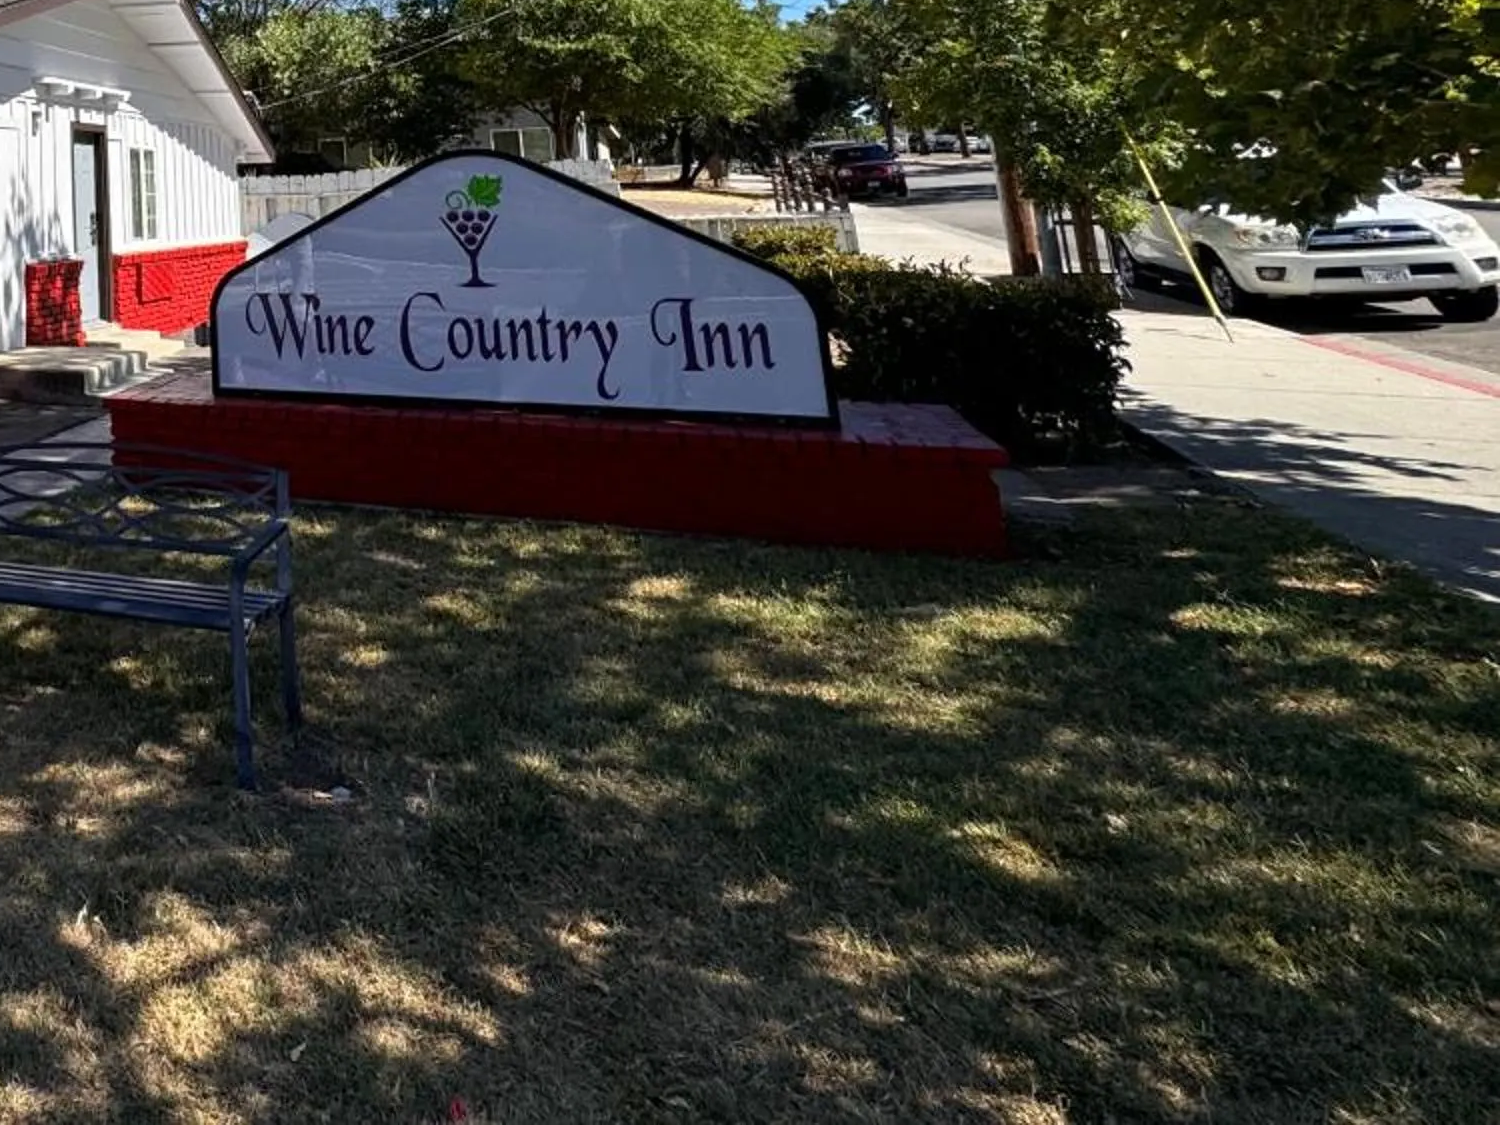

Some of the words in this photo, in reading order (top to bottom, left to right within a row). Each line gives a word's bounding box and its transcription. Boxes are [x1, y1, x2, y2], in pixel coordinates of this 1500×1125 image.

[245, 291, 375, 360] Wine
[401, 291, 619, 400] Country
[650, 297, 776, 372] Inn
